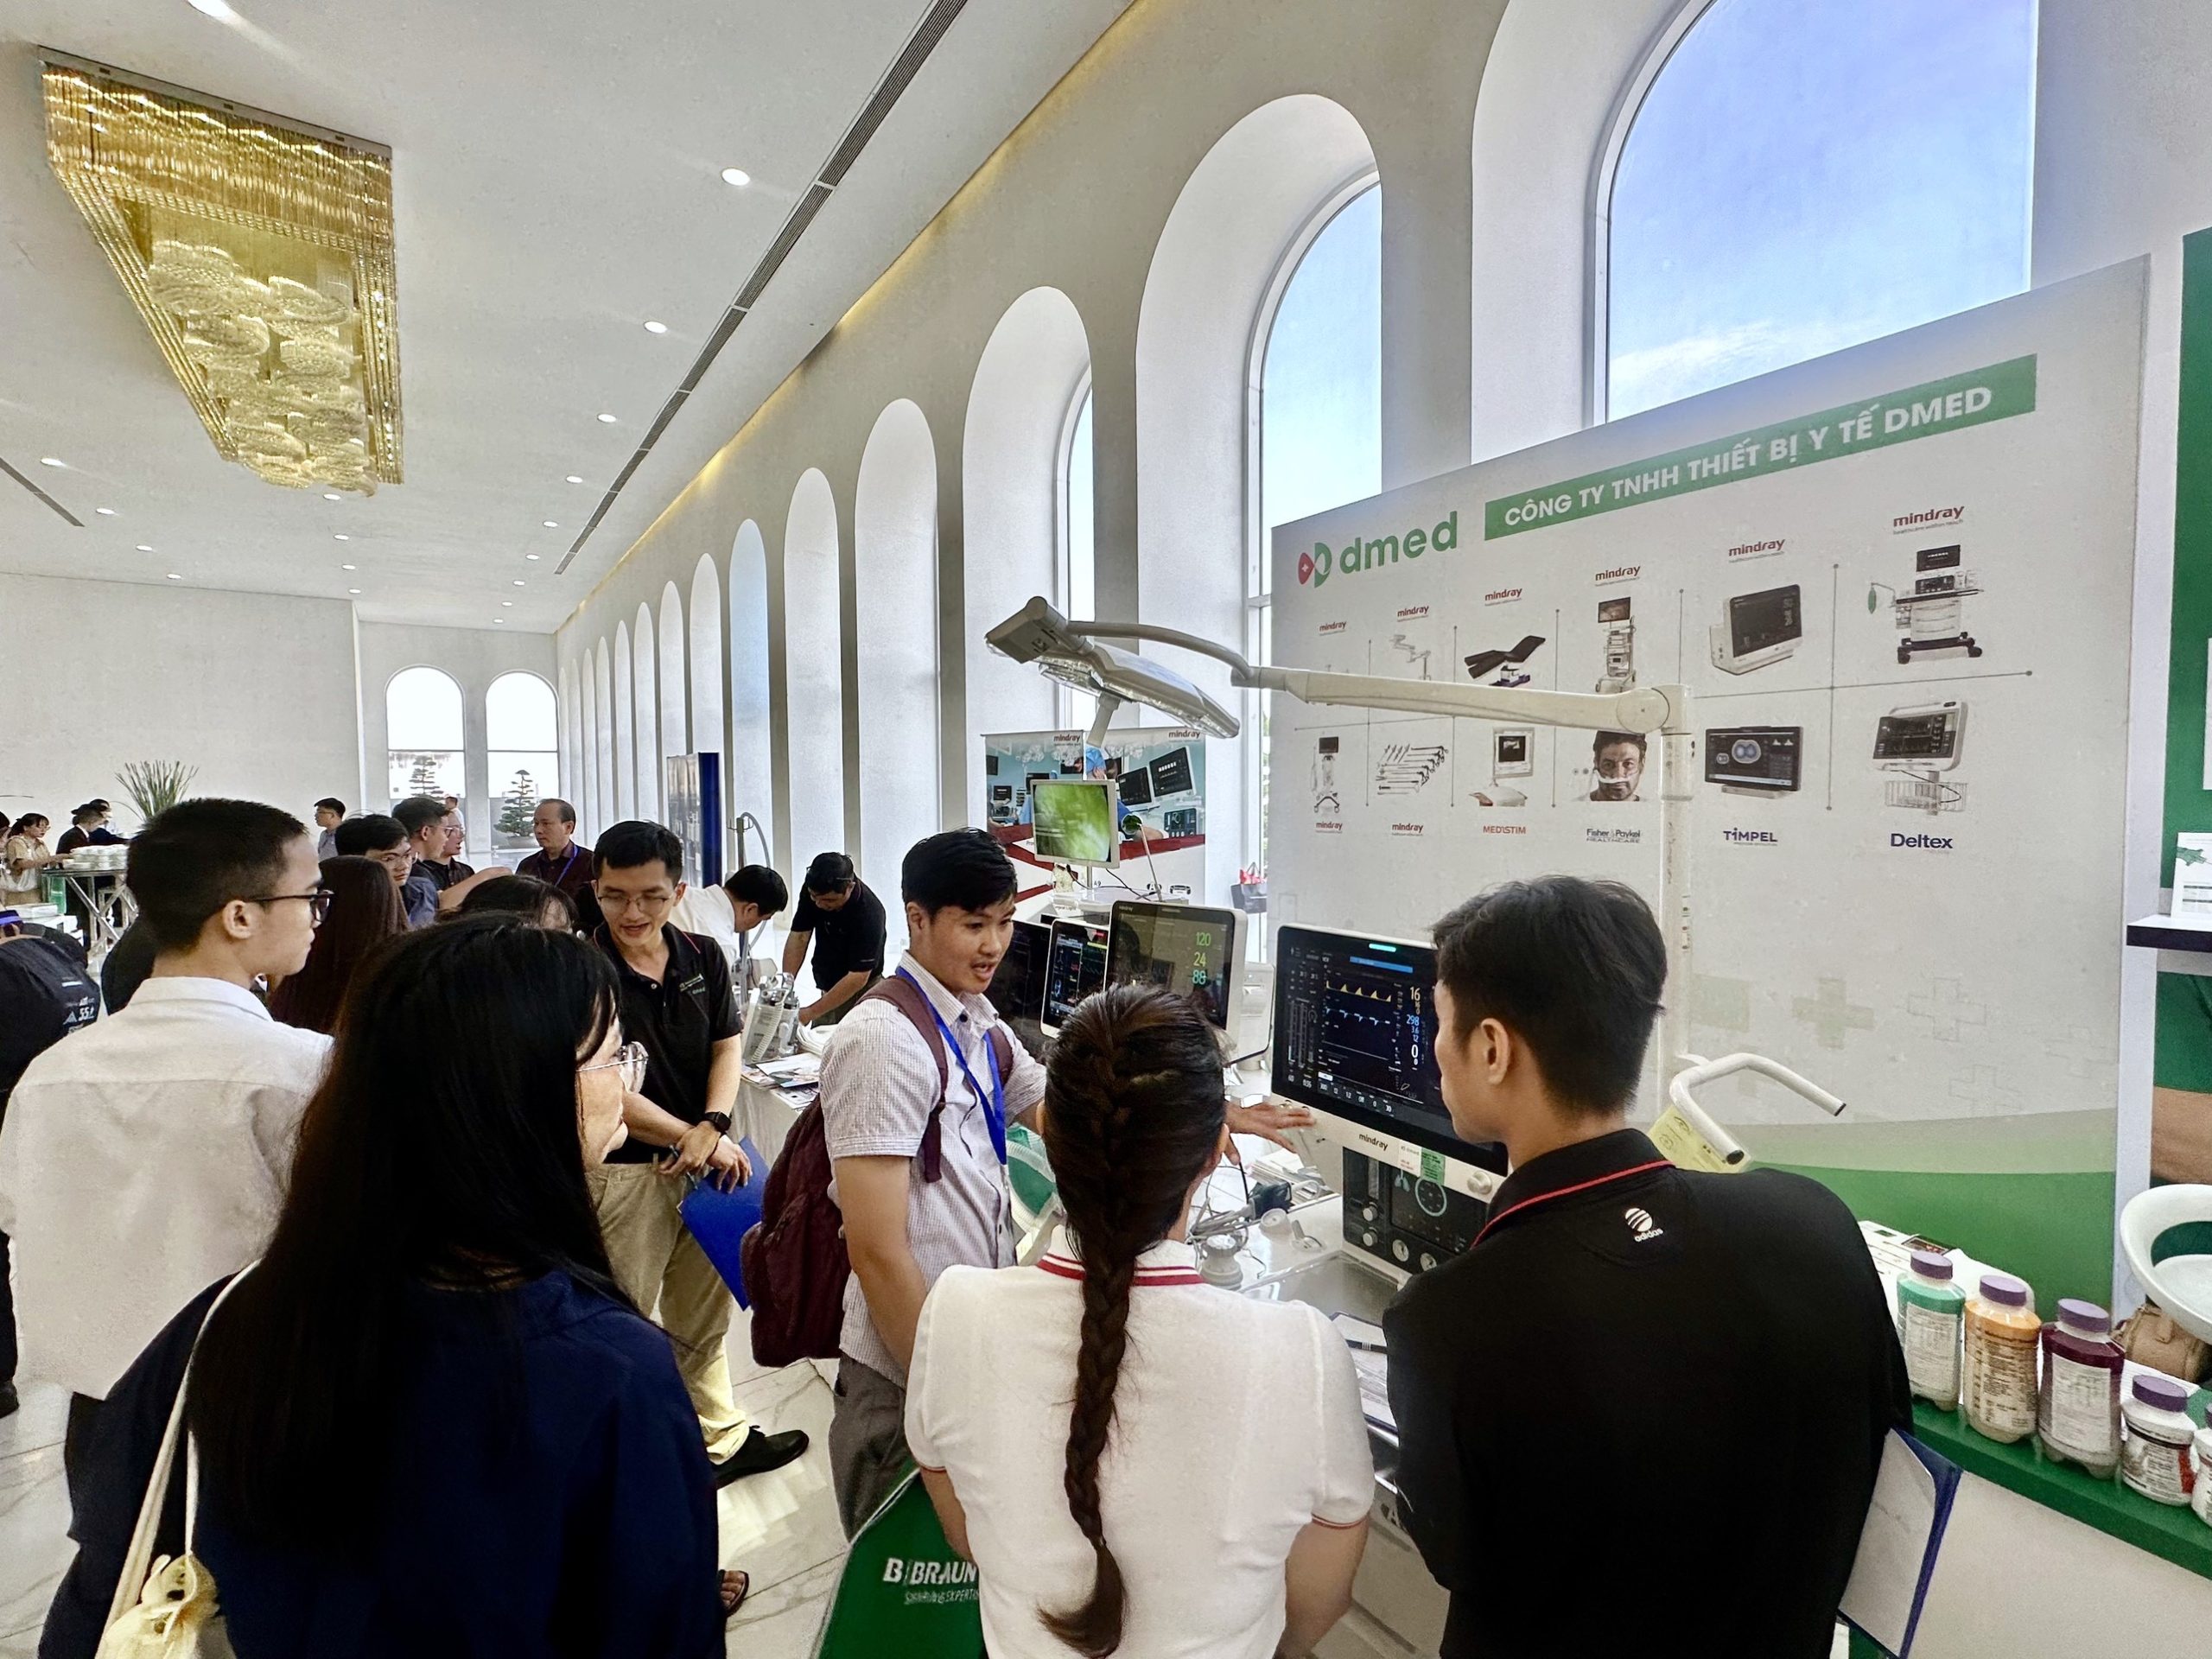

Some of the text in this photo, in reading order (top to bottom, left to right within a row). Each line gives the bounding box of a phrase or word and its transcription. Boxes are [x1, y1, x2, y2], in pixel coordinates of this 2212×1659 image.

[1504, 386, 1993, 525] CÔNG TY TNHH THIẾT BỊ Y TẾ DMED
[1893, 505, 1965, 527] mindray
[1339, 510, 1458, 574] dmed
[1729, 538, 1785, 557] mindray
[1595, 565, 1641, 582] mindray
[1484, 588, 1522, 601] mindray
[1397, 606, 1429, 618] mindray
[1319, 621, 1346, 632] mindray
[1053, 734, 1081, 742] mindray
[1169, 730, 1201, 739] mindray
[1316, 821, 1343, 831] mindray
[1392, 823, 1423, 834] mindray
[1890, 833, 1954, 849] Deltex
[1196, 931, 1211, 947] 120
[1193, 951, 1207, 967] 24
[1192, 969, 1206, 985] 88
[1409, 986, 1421, 1002] 16
[1406, 1014, 1420, 1027] 298
[1411, 1044, 1419, 1058] 0
[1358, 1133, 1389, 1151] mindray
